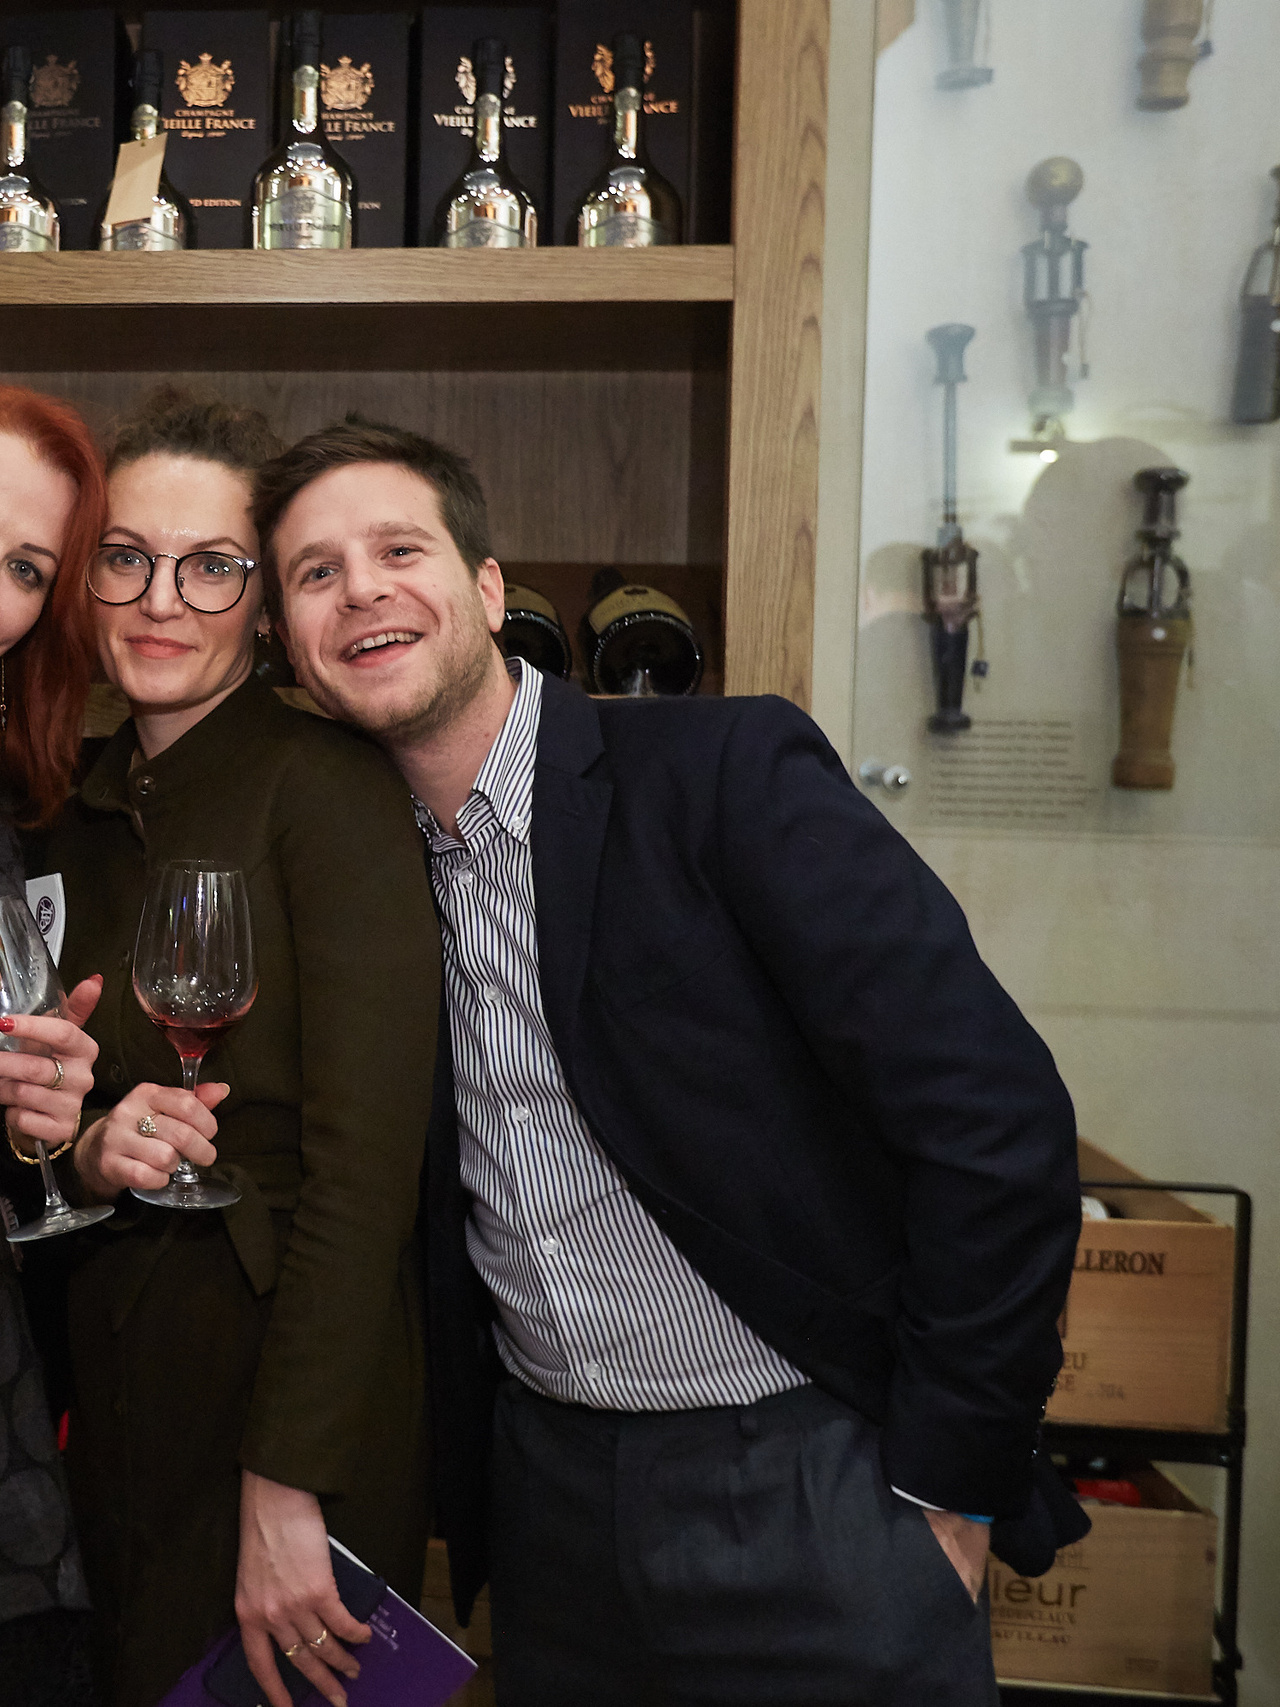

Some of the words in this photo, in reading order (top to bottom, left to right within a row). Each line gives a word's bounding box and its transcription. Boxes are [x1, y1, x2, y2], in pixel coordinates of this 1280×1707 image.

[205, 117, 257, 130] FRANCE
[344, 120, 396, 133] FRANCE
[992, 1569, 1088, 1608] leur
